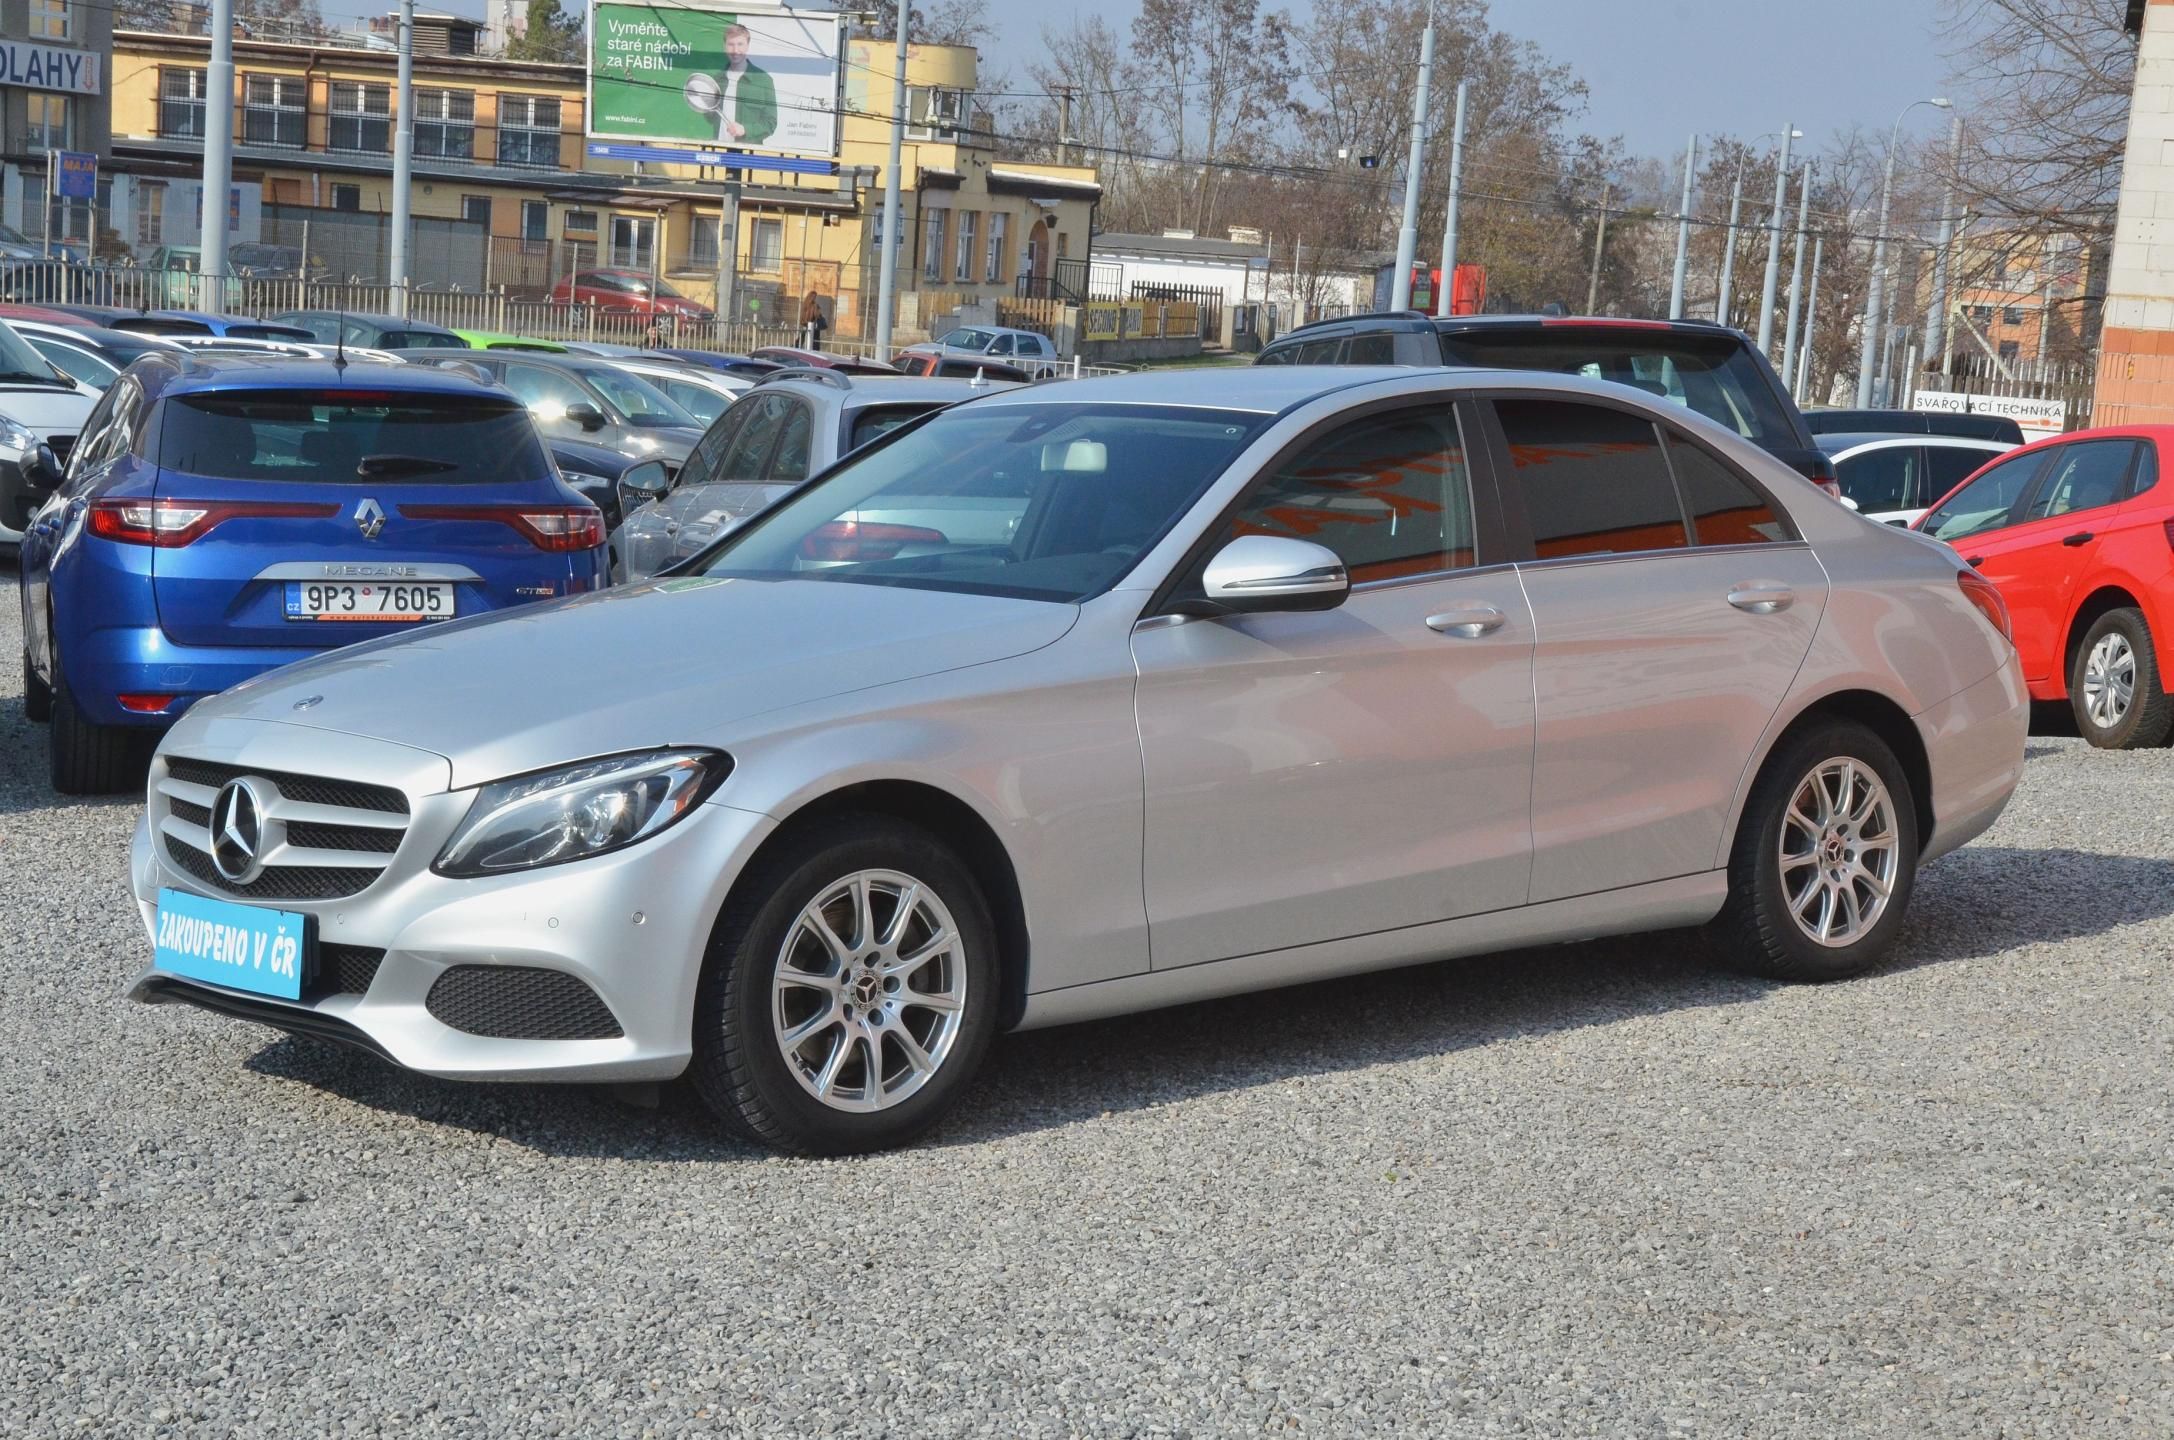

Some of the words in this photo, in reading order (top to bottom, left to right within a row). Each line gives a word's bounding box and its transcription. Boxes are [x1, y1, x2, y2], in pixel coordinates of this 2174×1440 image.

[608, 18, 669, 37] Vyměňte
[607, 37, 642, 52] staré
[645, 40, 692, 56] nádobí
[607, 56, 622, 67] za
[625, 54, 673, 71] FABINI
[1088, 308, 1118, 333] SECOND
[1997, 403, 2062, 417] TECHNIKA
[325, 565, 417, 577] MEGANE
[287, 603, 300, 611] CZ
[307, 585, 356, 612] 9P3
[377, 586, 441, 612] 7605
[158, 911, 248, 967] ZAKOUPENO
[254, 931, 268, 970] V
[270, 925, 297, 980] ČR
